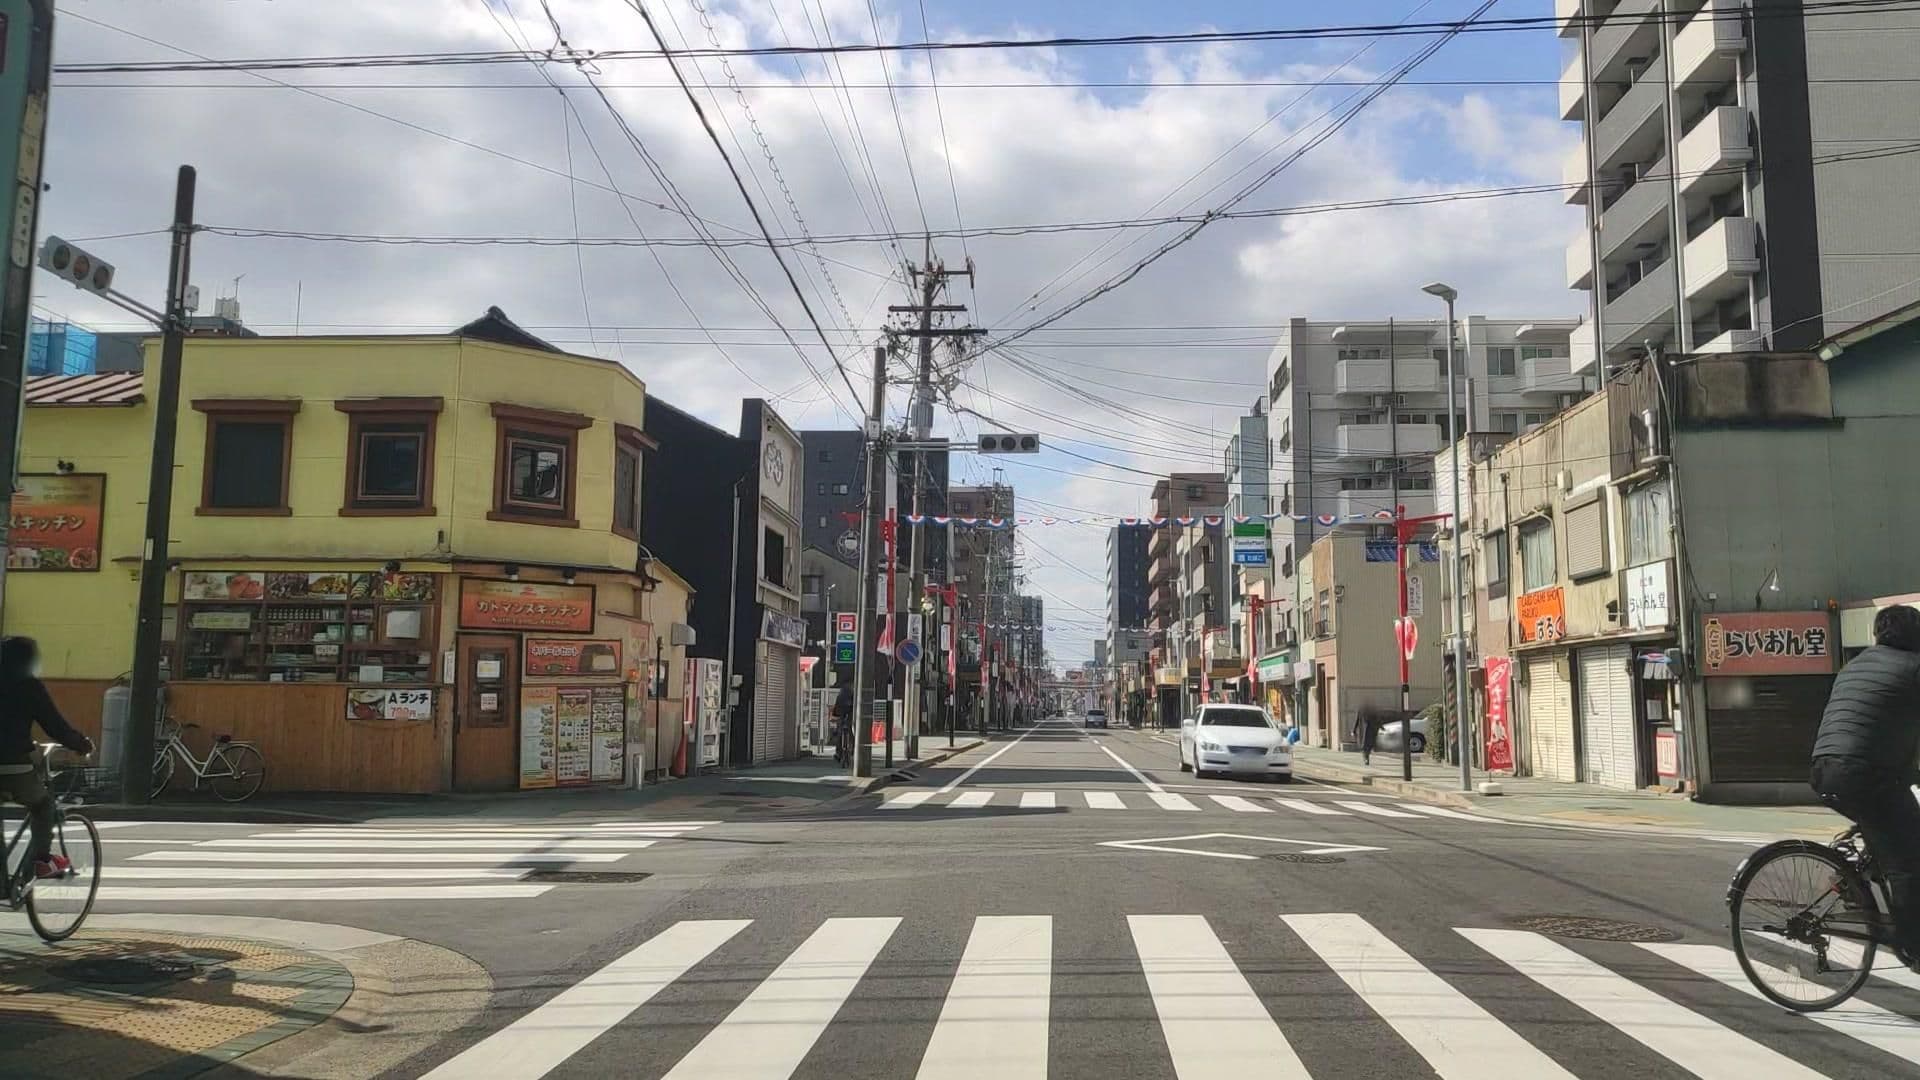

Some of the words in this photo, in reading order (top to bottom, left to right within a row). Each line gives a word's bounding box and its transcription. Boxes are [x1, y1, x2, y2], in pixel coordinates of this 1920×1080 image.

[1725, 627, 1826, 657] らいおん堂
